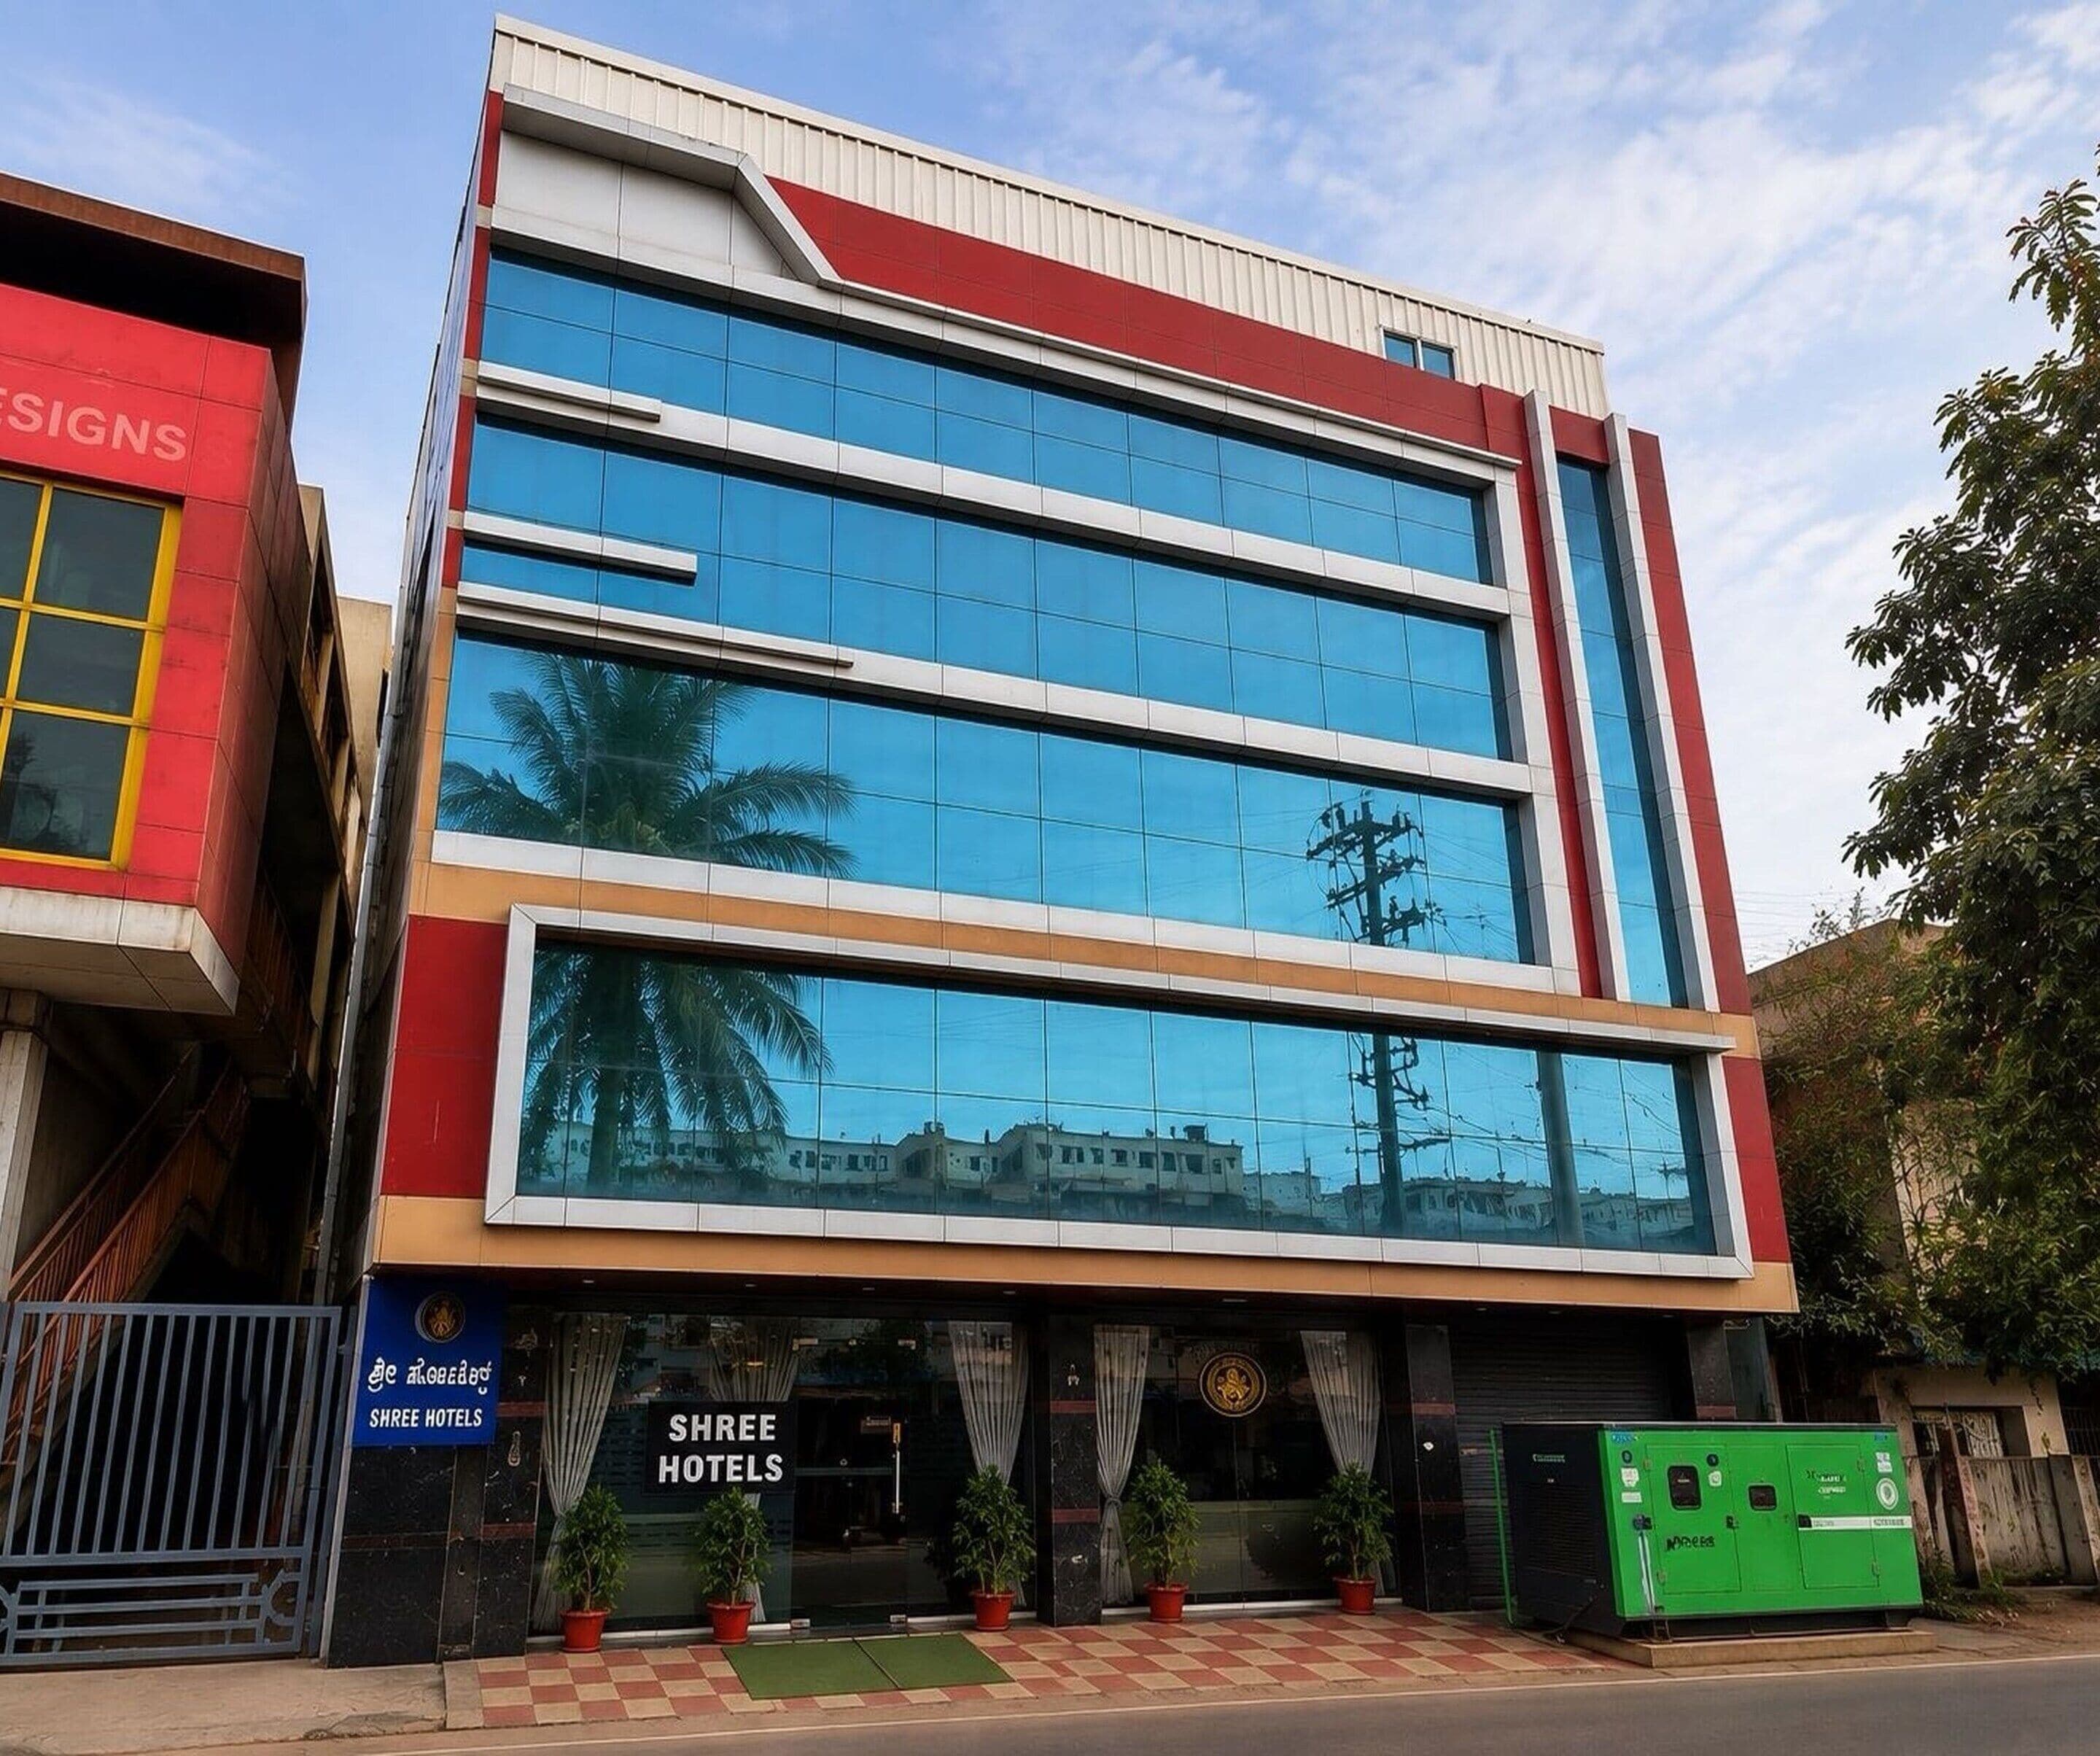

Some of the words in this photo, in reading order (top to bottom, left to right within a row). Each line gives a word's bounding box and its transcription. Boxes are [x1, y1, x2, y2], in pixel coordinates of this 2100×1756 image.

[0, 388, 187, 461] SIGNS
[369, 1408, 420, 1428] SHREE
[425, 1408, 483, 1428] HOTELS
[669, 1413, 776, 1442] SHREE
[658, 1453, 783, 1483] HOTELS
